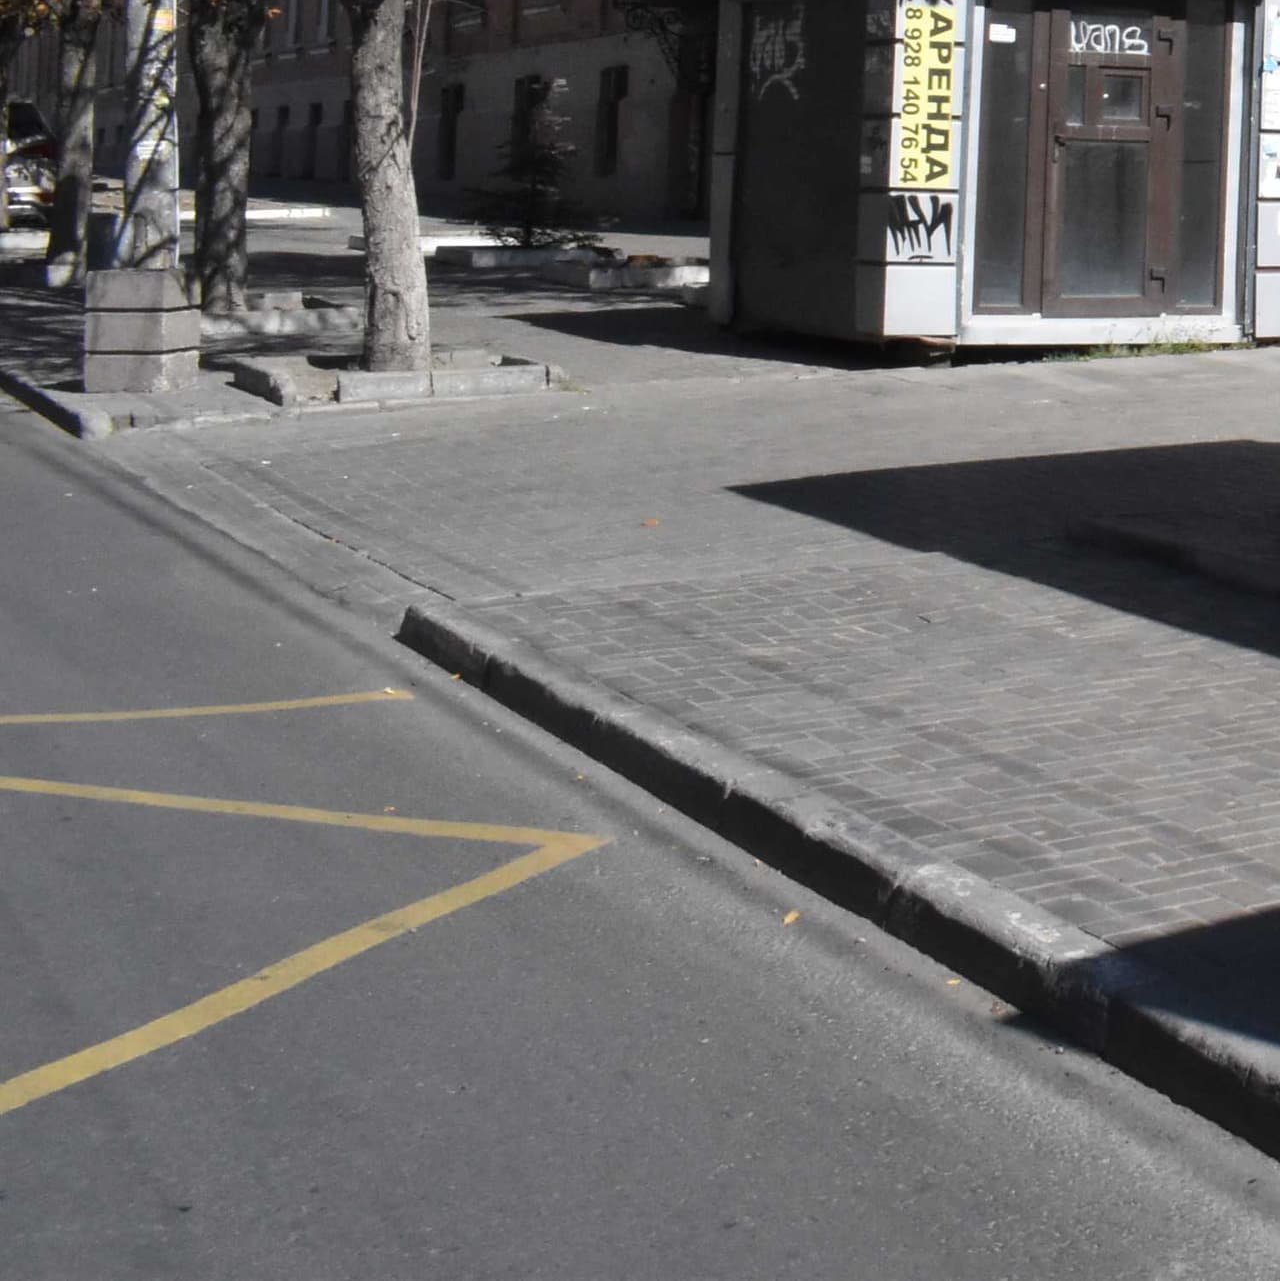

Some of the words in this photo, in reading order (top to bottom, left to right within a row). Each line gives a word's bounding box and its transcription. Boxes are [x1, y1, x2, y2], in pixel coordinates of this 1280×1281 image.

[904, 7, 923, 20] 8
[902, 28, 923, 68] 928
[902, 75, 921, 115] 140
[921, 9, 953, 184] АРЕНДА
[900, 122, 919, 150] 76
[899, 156, 918, 185] 54
